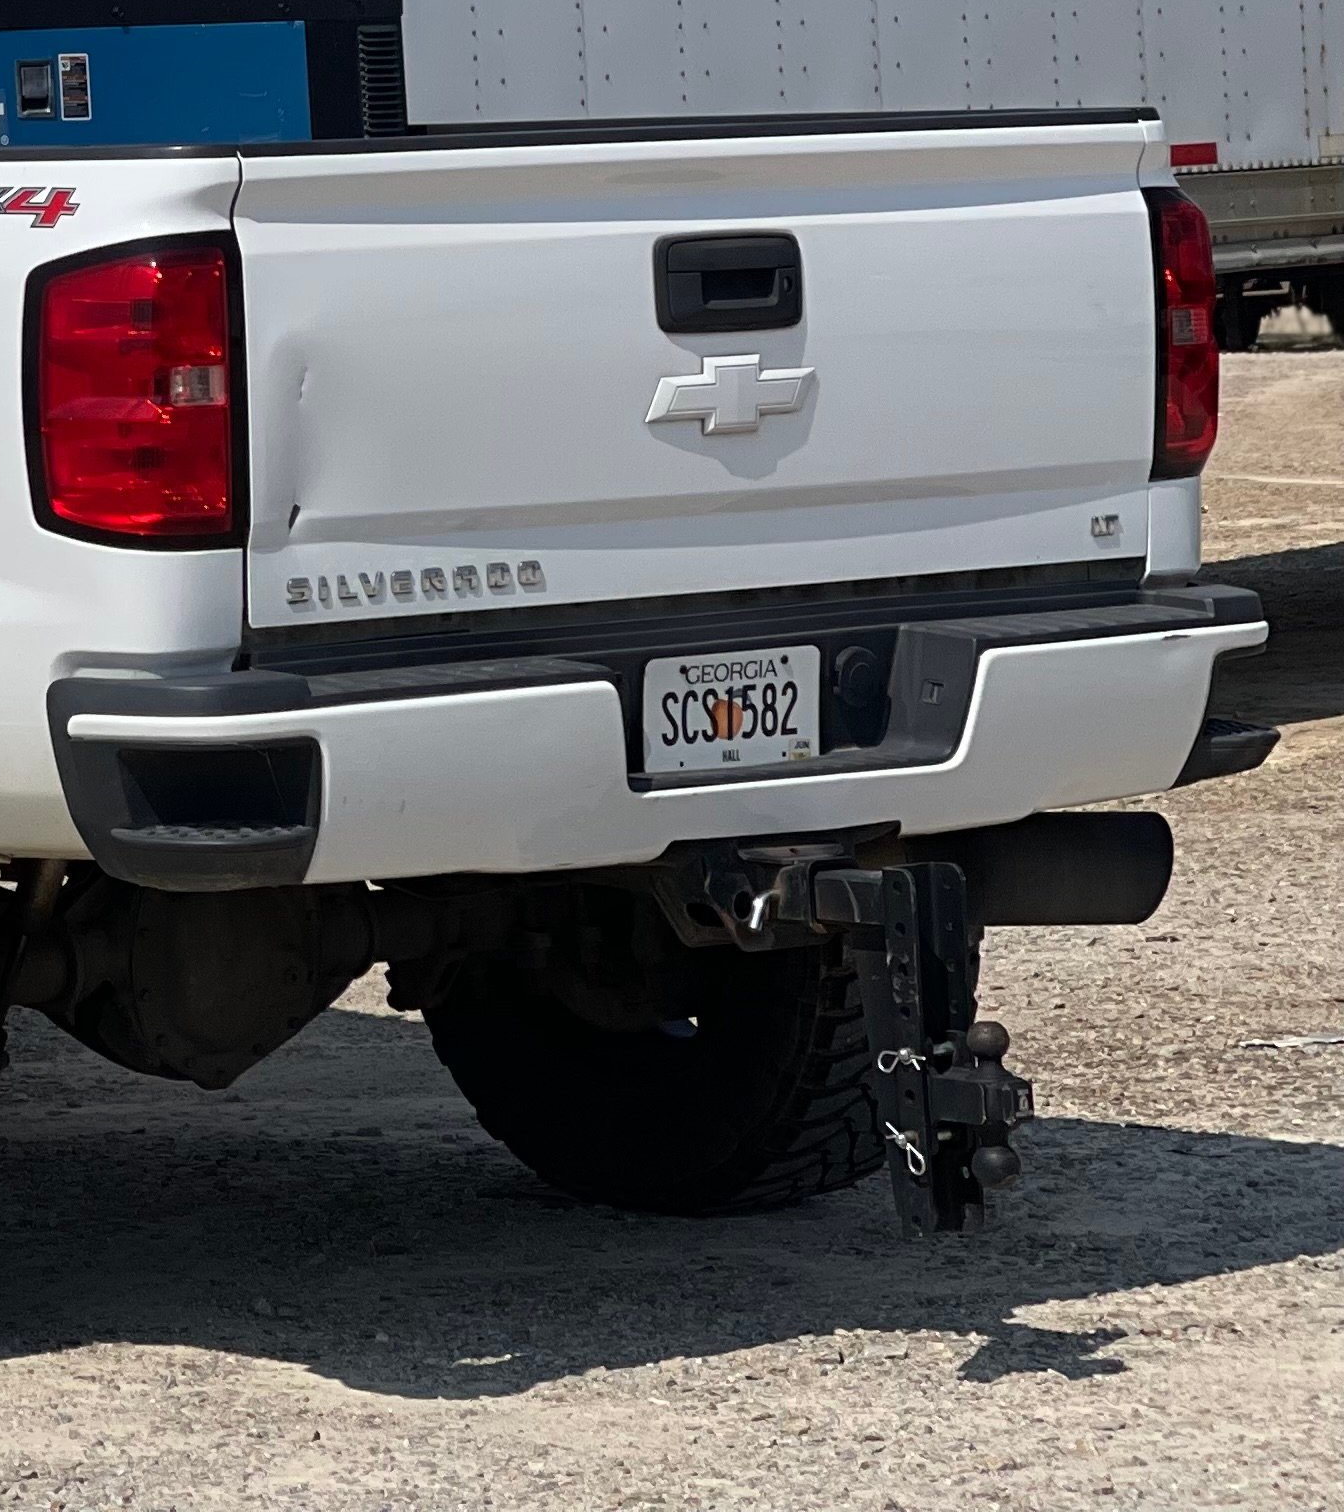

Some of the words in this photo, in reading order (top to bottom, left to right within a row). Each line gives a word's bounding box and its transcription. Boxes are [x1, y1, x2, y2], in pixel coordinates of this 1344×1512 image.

[286, 560, 542, 605] SILVERADO
[684, 659, 778, 685] GEORGIA
[662, 681, 798, 746] SCS1582
[722, 749, 741, 762] HALL
